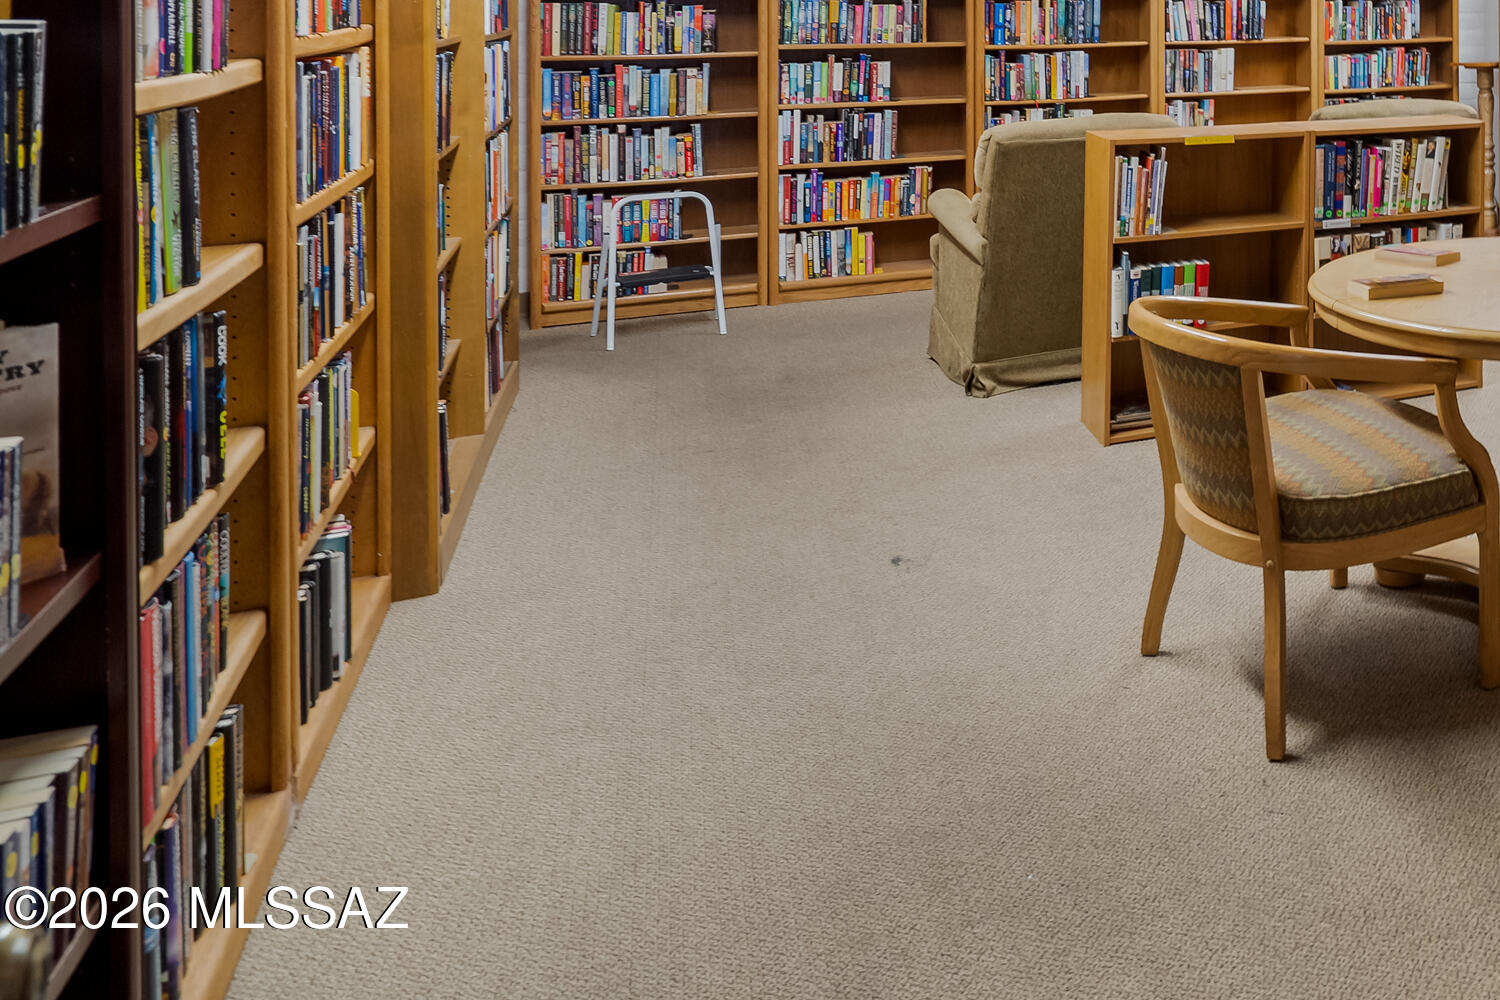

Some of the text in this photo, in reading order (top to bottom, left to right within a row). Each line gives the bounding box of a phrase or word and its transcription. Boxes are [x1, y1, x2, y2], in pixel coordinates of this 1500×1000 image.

[1393, 143, 1403, 174] WIRED
[217, 324, 228, 367] COOK
[0, 359, 45, 381] RY
